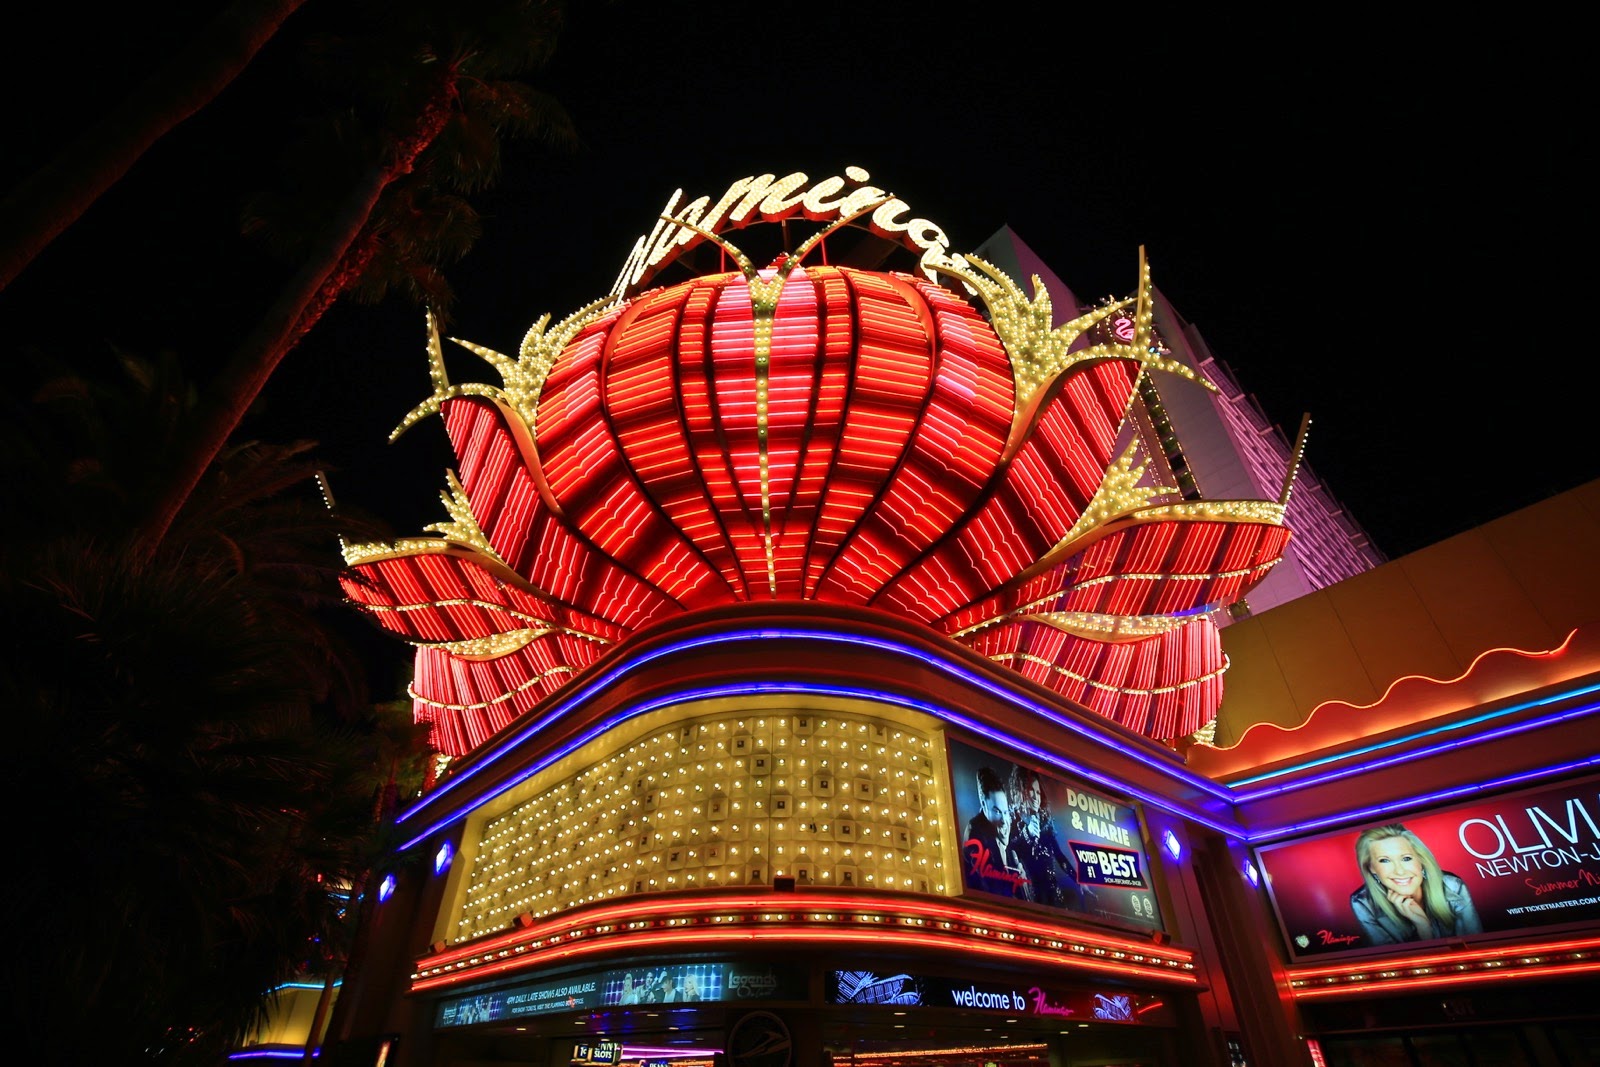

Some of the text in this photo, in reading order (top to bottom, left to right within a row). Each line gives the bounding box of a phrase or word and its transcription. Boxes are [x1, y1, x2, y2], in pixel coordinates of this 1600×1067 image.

[1066, 788, 1117, 822] DONNY
[1071, 811, 1131, 847] & MARIE
[1458, 793, 1600, 860] OLIVI
[964, 838, 1032, 893] Flamingo
[1076, 849, 1138, 878] VOTED BEST
[1087, 865, 1096, 879] #1
[1525, 878, 1579, 896] Summer
[1507, 907, 1525, 915] VISIT
[1525, 897, 1598, 913] TICKETMASTER.COM
[1317, 929, 1360, 945] Flamingo
[538, 989, 555, 1000] SHOWS
[555, 987, 568, 997] ALSO
[951, 985, 1074, 1016] welcome to Flamingo
[593, 1050, 613, 1059] SLOTS
